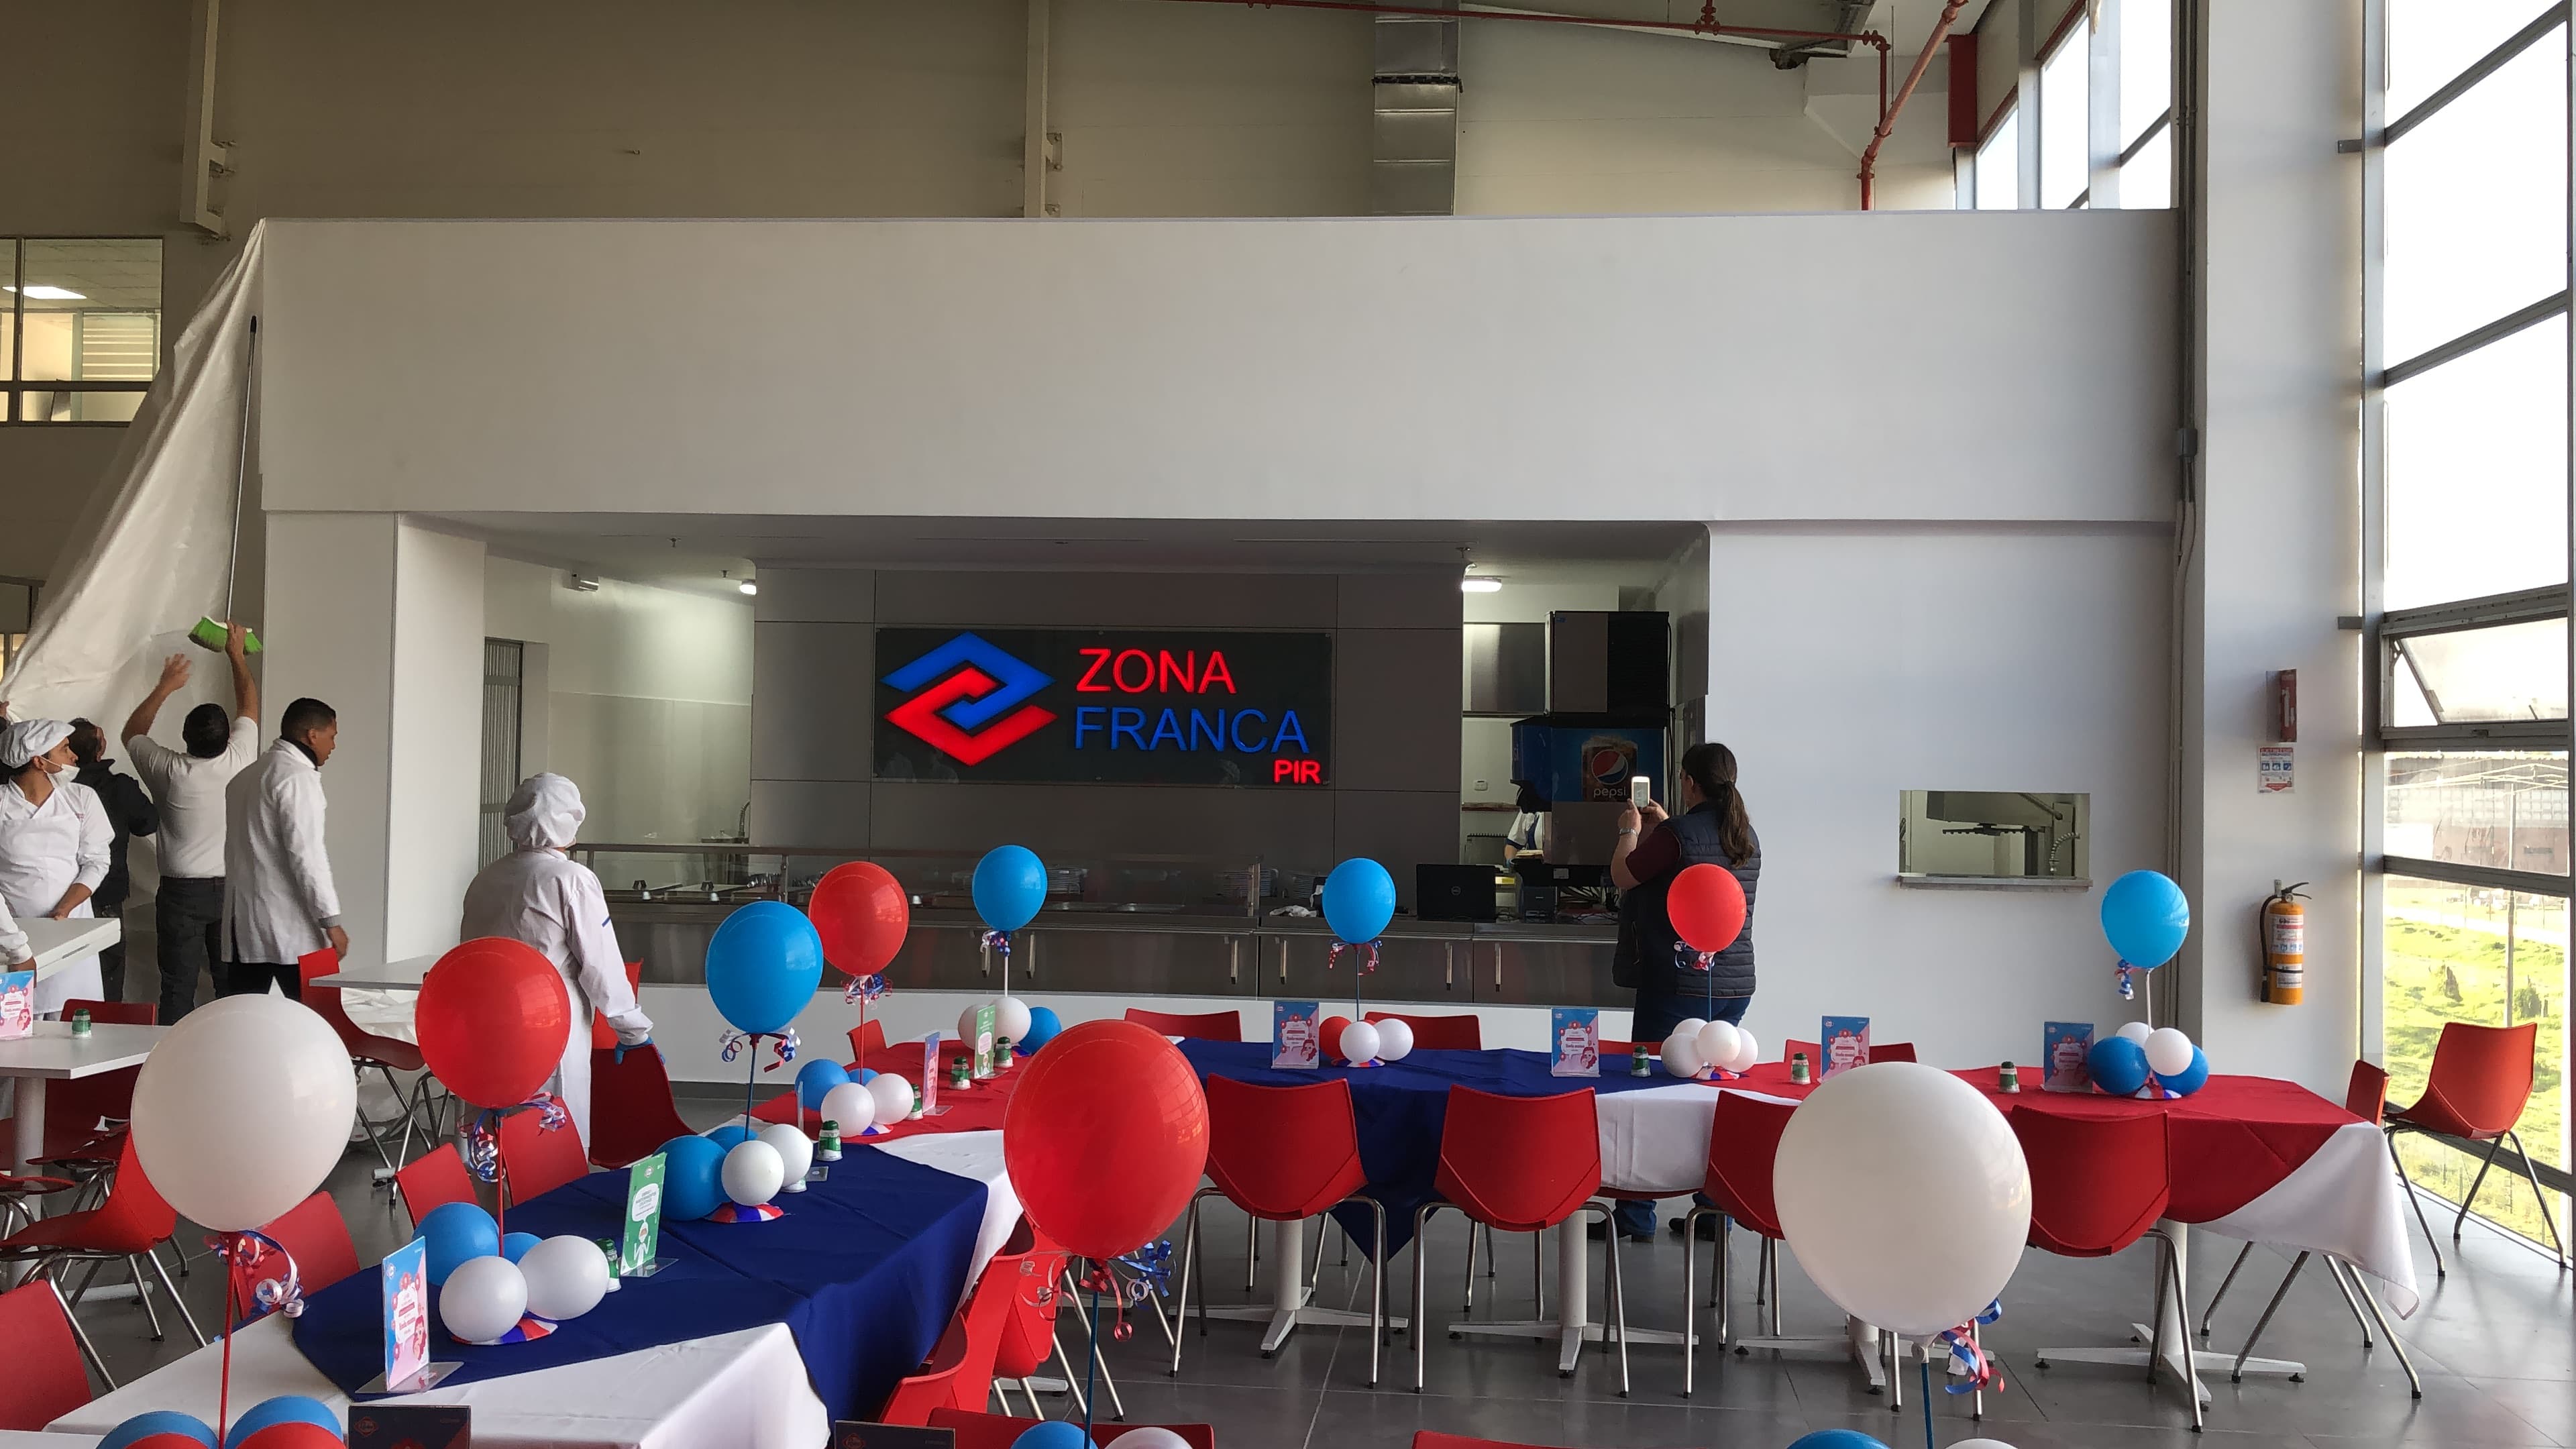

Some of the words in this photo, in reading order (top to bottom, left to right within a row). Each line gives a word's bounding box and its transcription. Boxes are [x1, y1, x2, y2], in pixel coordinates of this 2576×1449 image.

[1076, 649, 1236, 694] ZONA
[1075, 707, 1309, 753] FRANCA
[1274, 760, 1321, 784] PIR
[1593, 786, 1626, 798] pepsi
